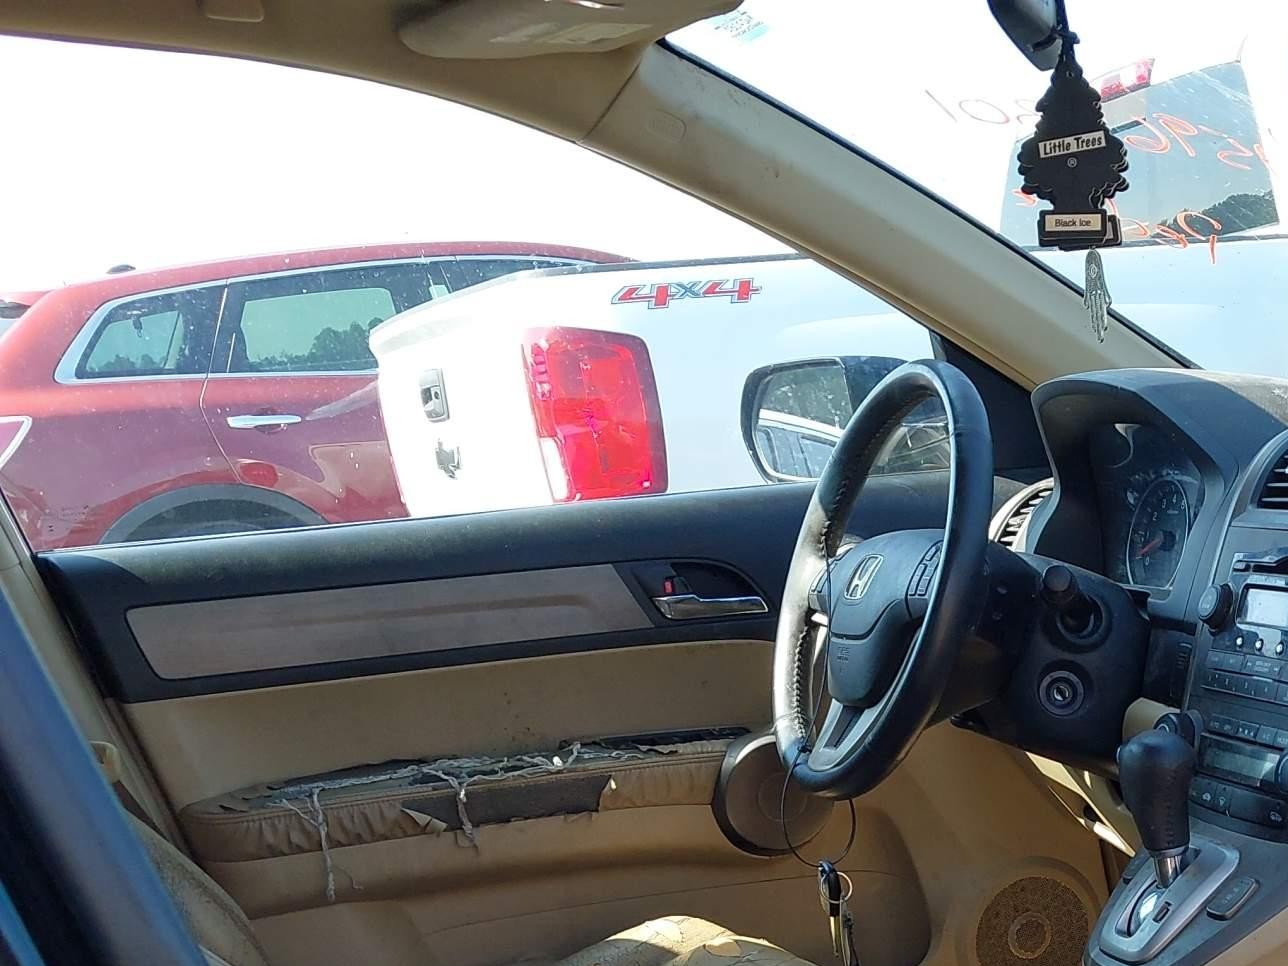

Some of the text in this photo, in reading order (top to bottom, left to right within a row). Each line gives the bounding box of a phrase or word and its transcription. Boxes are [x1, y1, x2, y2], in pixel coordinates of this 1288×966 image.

[1042, 135, 1103, 156] Little Trees
[1054, 218, 1092, 228] Black Ice
[611, 277, 763, 310] 4x4
